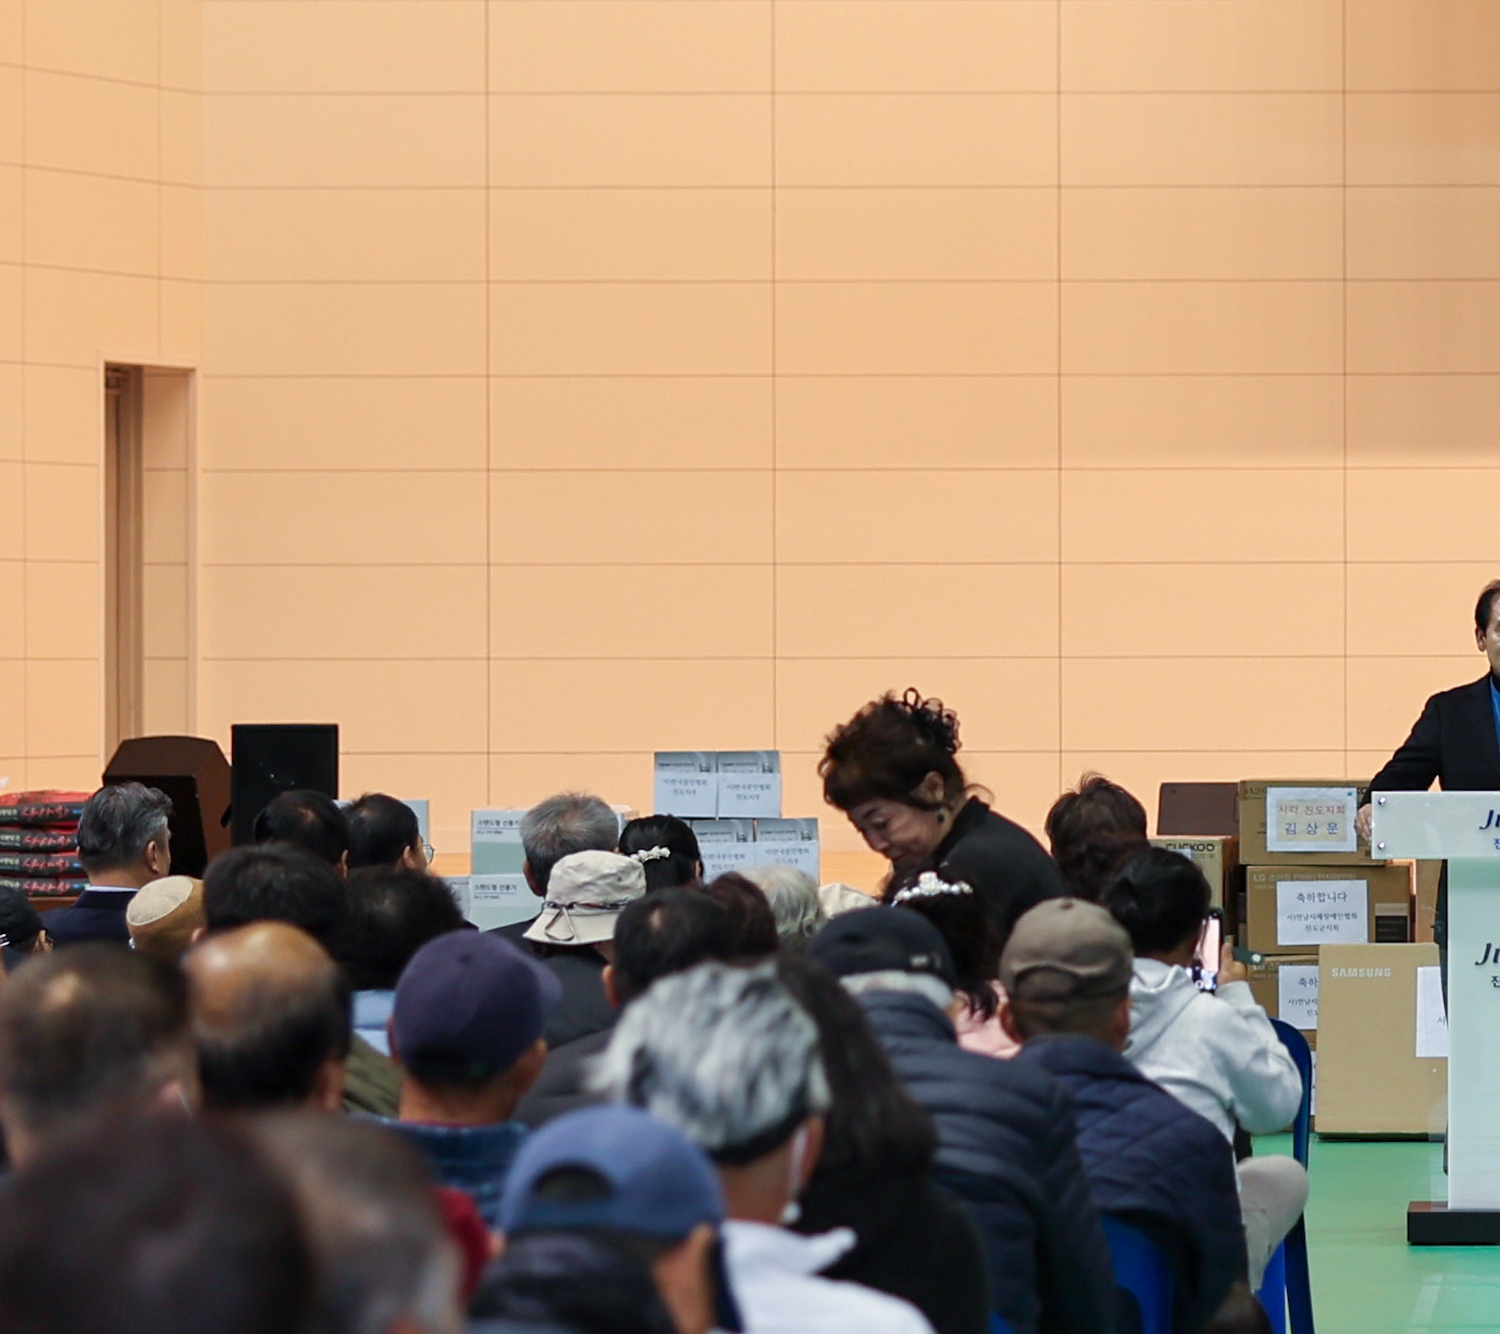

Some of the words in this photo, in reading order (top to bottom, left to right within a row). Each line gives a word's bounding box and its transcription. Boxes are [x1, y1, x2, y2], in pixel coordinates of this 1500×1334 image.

[1304, 804, 1347, 817] 진도지회
[1296, 891, 1348, 903] 축하합니다
[1331, 967, 1392, 978] SAMSUNG
